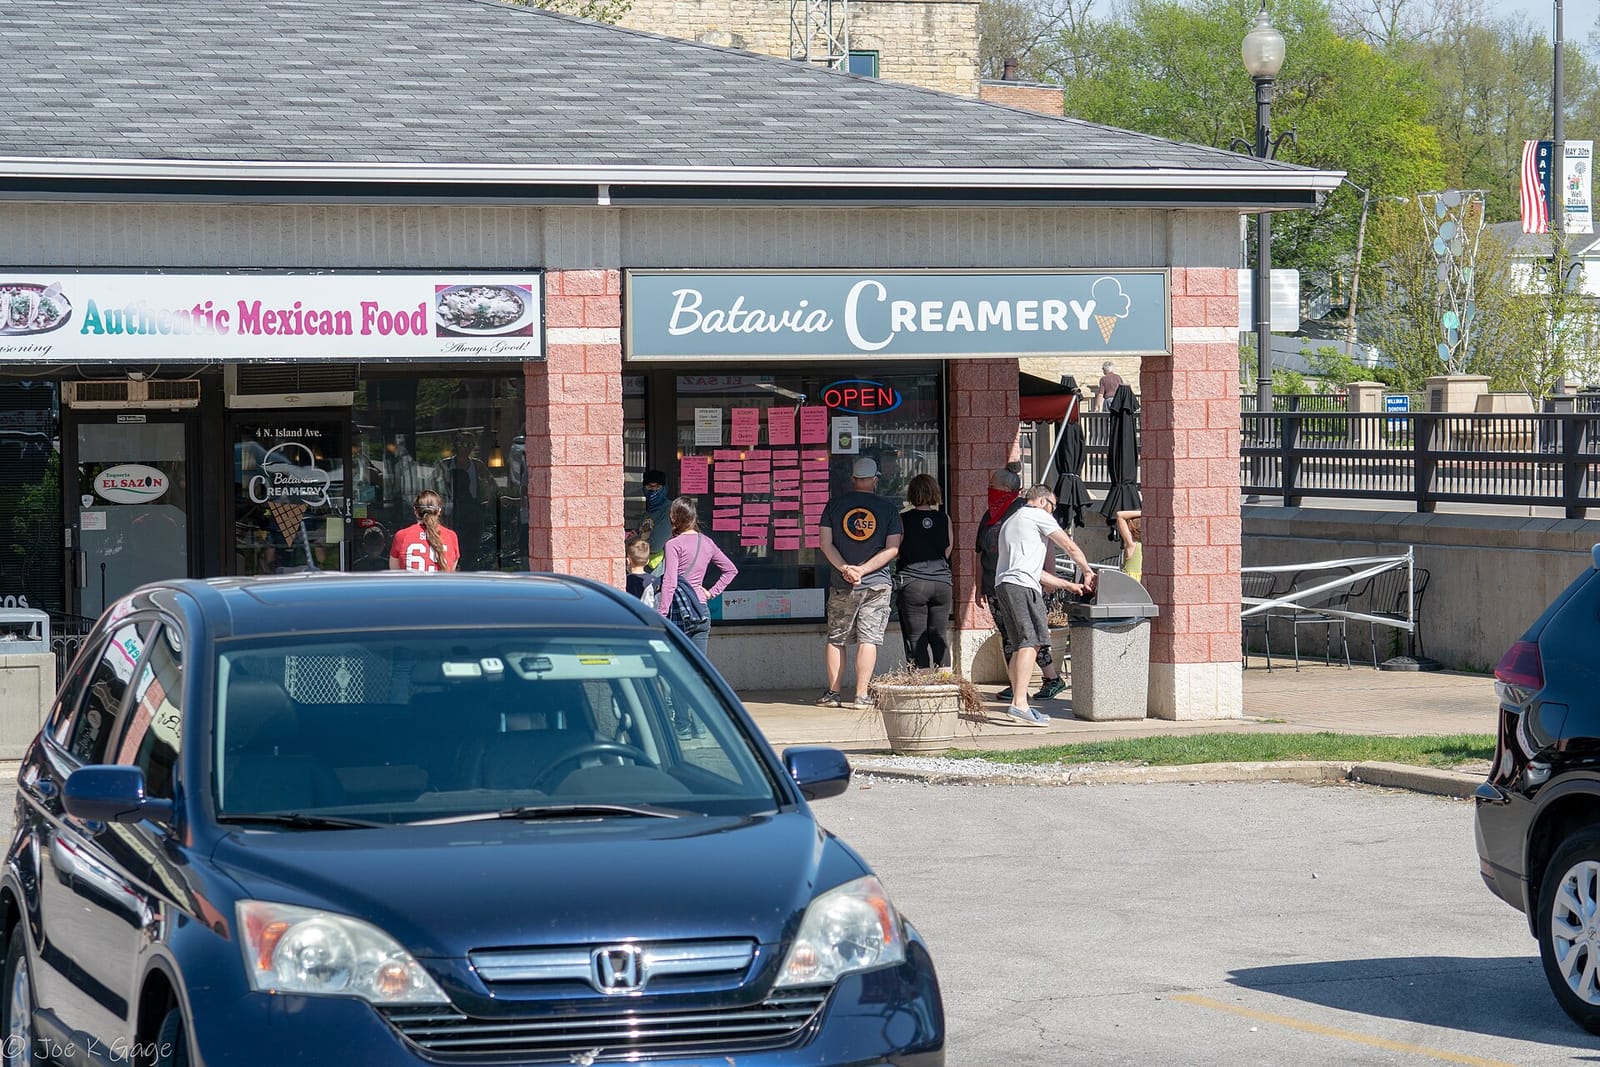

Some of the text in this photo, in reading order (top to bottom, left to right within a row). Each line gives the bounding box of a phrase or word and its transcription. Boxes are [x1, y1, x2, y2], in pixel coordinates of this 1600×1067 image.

[80, 298, 429, 336] Authentic Mexican Food
[667, 280, 1096, 351] Batavia CREAMERY
[441, 341, 530, 354] Always Good!
[824, 387, 893, 408] OPEN
[255, 428, 322, 438] 4 N. Island Ave.
[103, 480, 118, 488] EL
[847, 511, 874, 537] CASE
